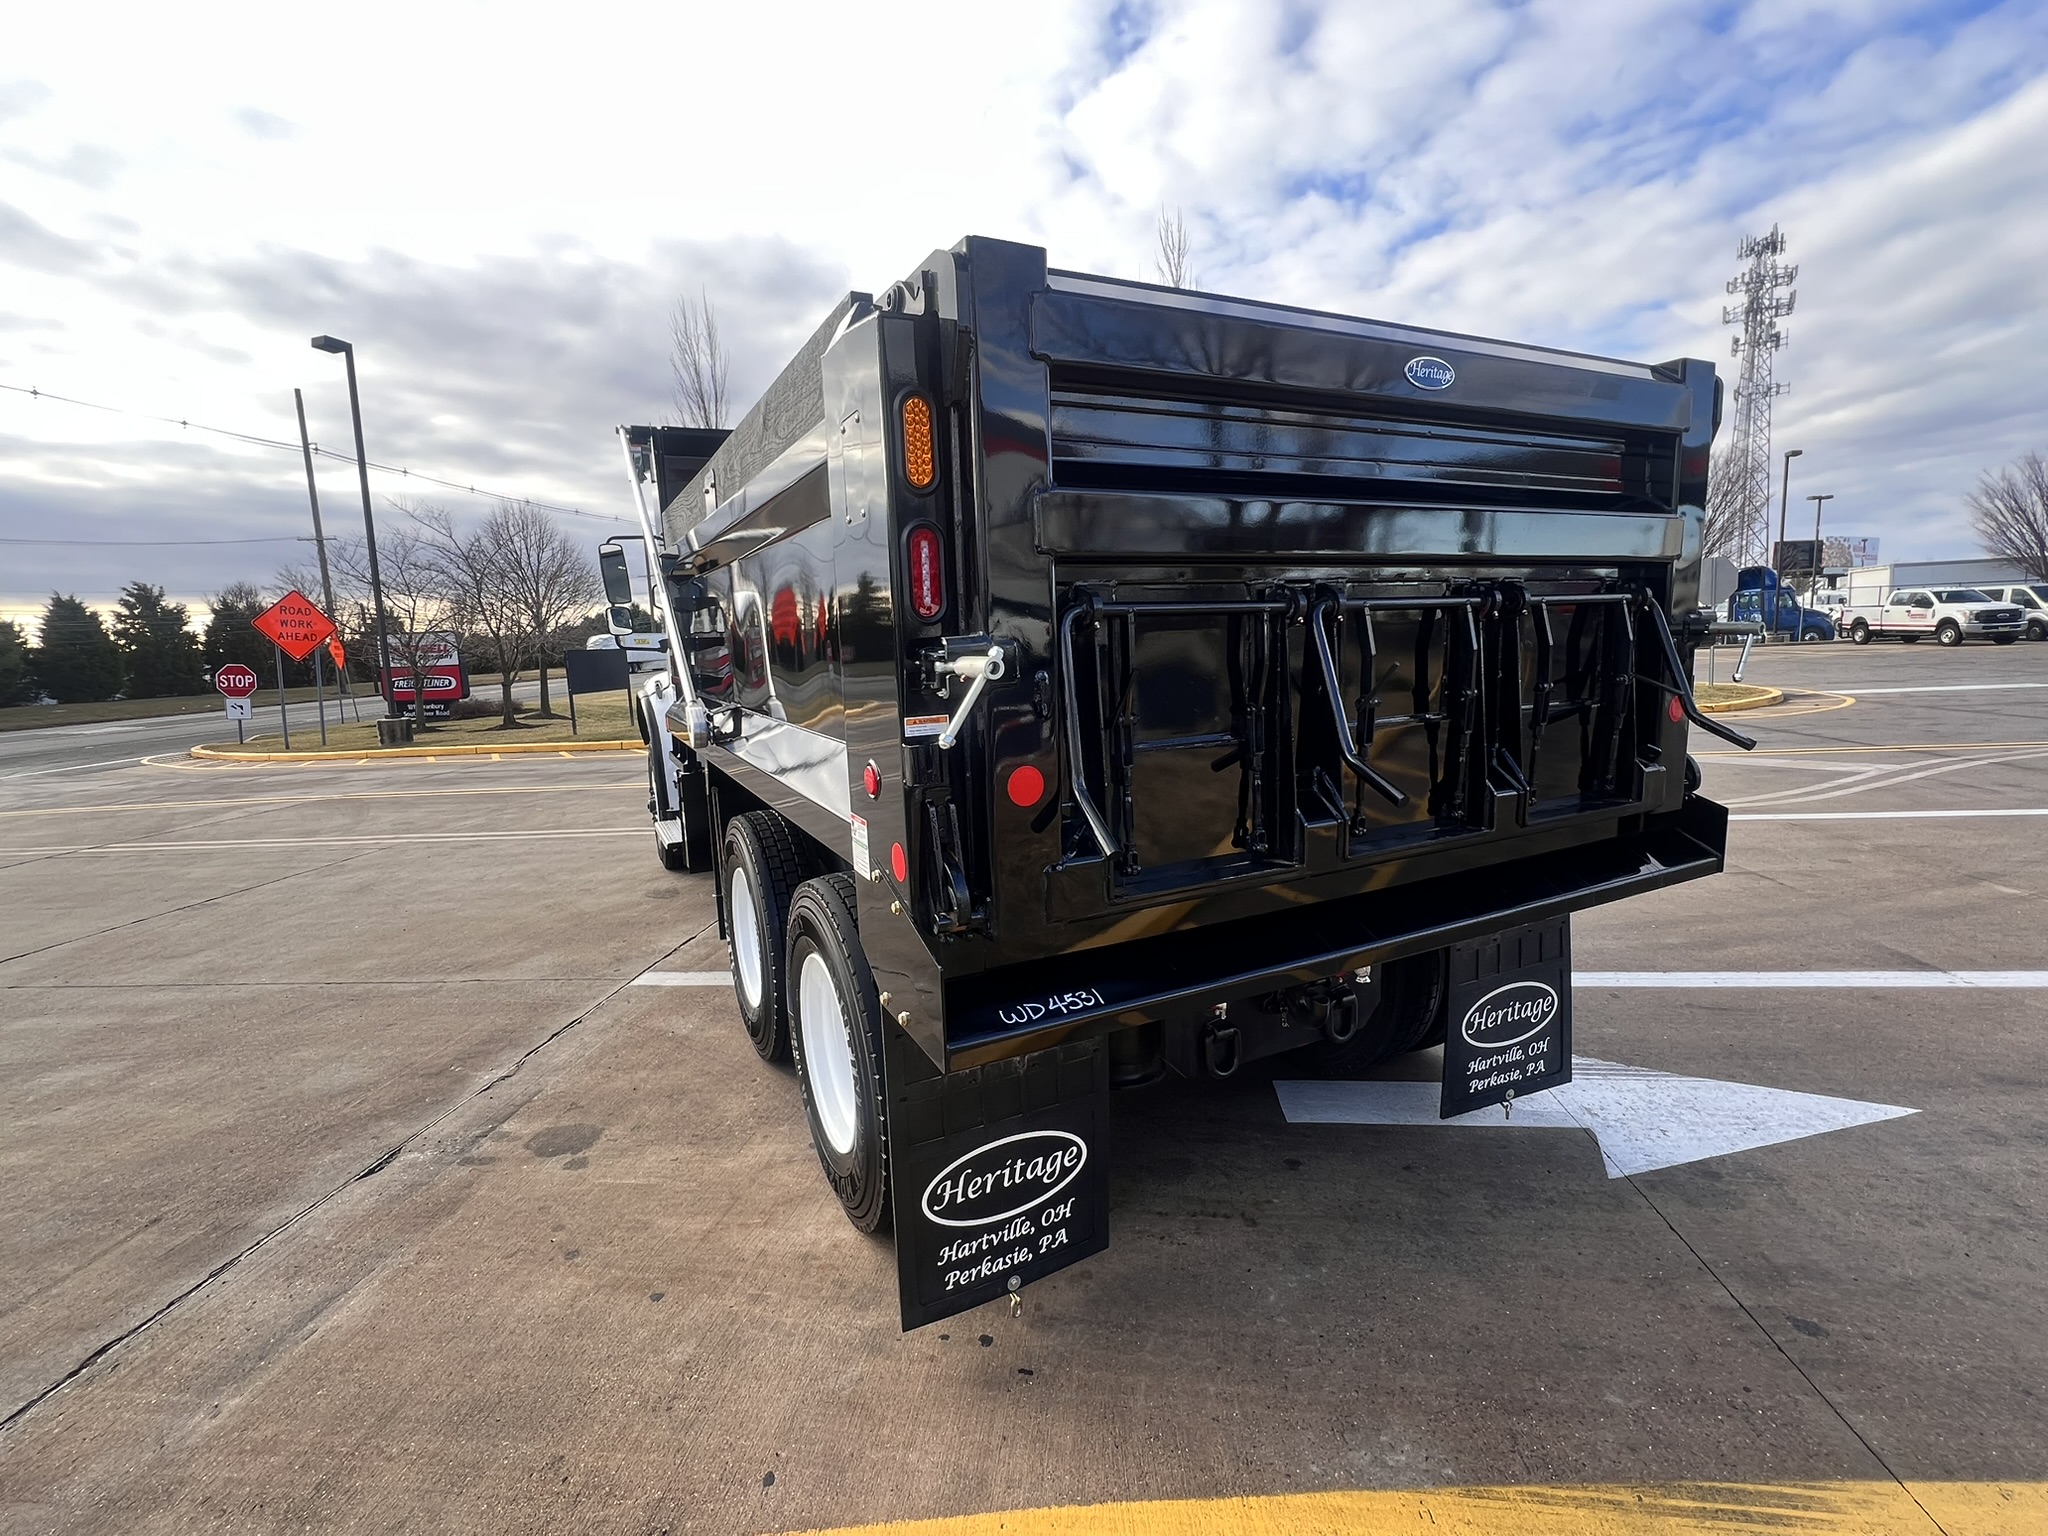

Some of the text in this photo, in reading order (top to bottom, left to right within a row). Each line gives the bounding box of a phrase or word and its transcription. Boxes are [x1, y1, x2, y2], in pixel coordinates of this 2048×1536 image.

[1409, 360, 1453, 384] Heritage
[280, 605, 311, 616] ROAD
[280, 619, 313, 629] WORK
[278, 632, 318, 642] AHEAD
[219, 675, 253, 687] STOP
[394, 679, 449, 688] FREIGTLINER
[1468, 995, 1553, 1034] Heritage
[1466, 1037, 1550, 1075] Hartville, OH
[1469, 1060, 1546, 1093] Perkasie, PA
[932, 1143, 1078, 1211] Heritage
[936, 1198, 1075, 1266] Hartville, OH
[944, 1229, 1069, 1290] Perkasie, PA
